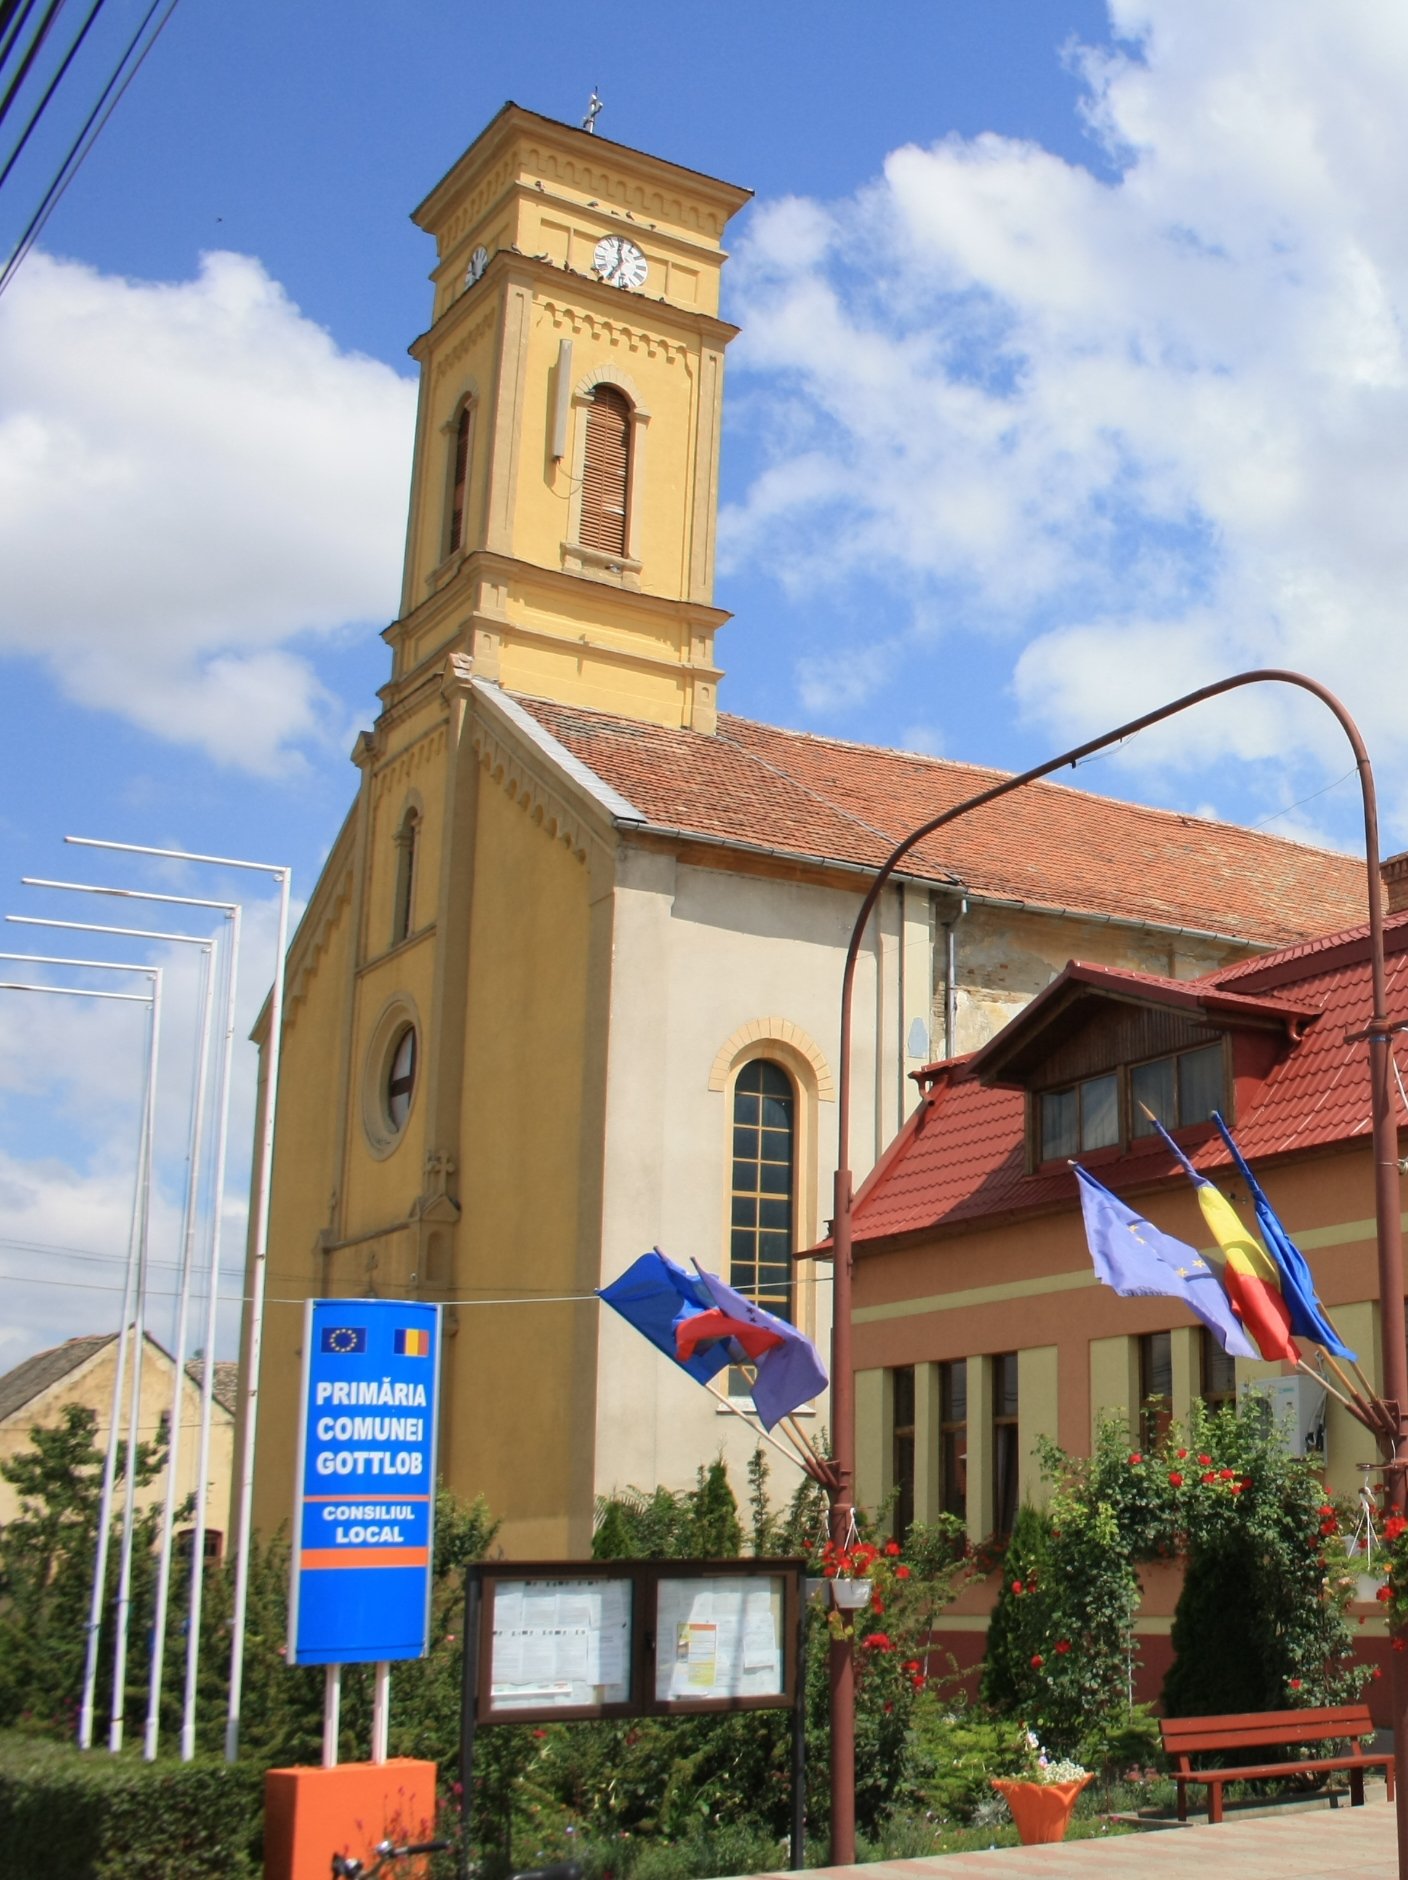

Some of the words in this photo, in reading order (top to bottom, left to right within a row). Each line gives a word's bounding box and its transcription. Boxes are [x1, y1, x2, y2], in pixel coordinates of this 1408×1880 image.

[316, 1377, 427, 1407] PRIMĂRIA
[317, 1417, 424, 1442] COMUNEI
[316, 1451, 423, 1475] GOTTLOB
[323, 1506, 415, 1520] CONSILIUL
[336, 1527, 404, 1543] LOCAL
